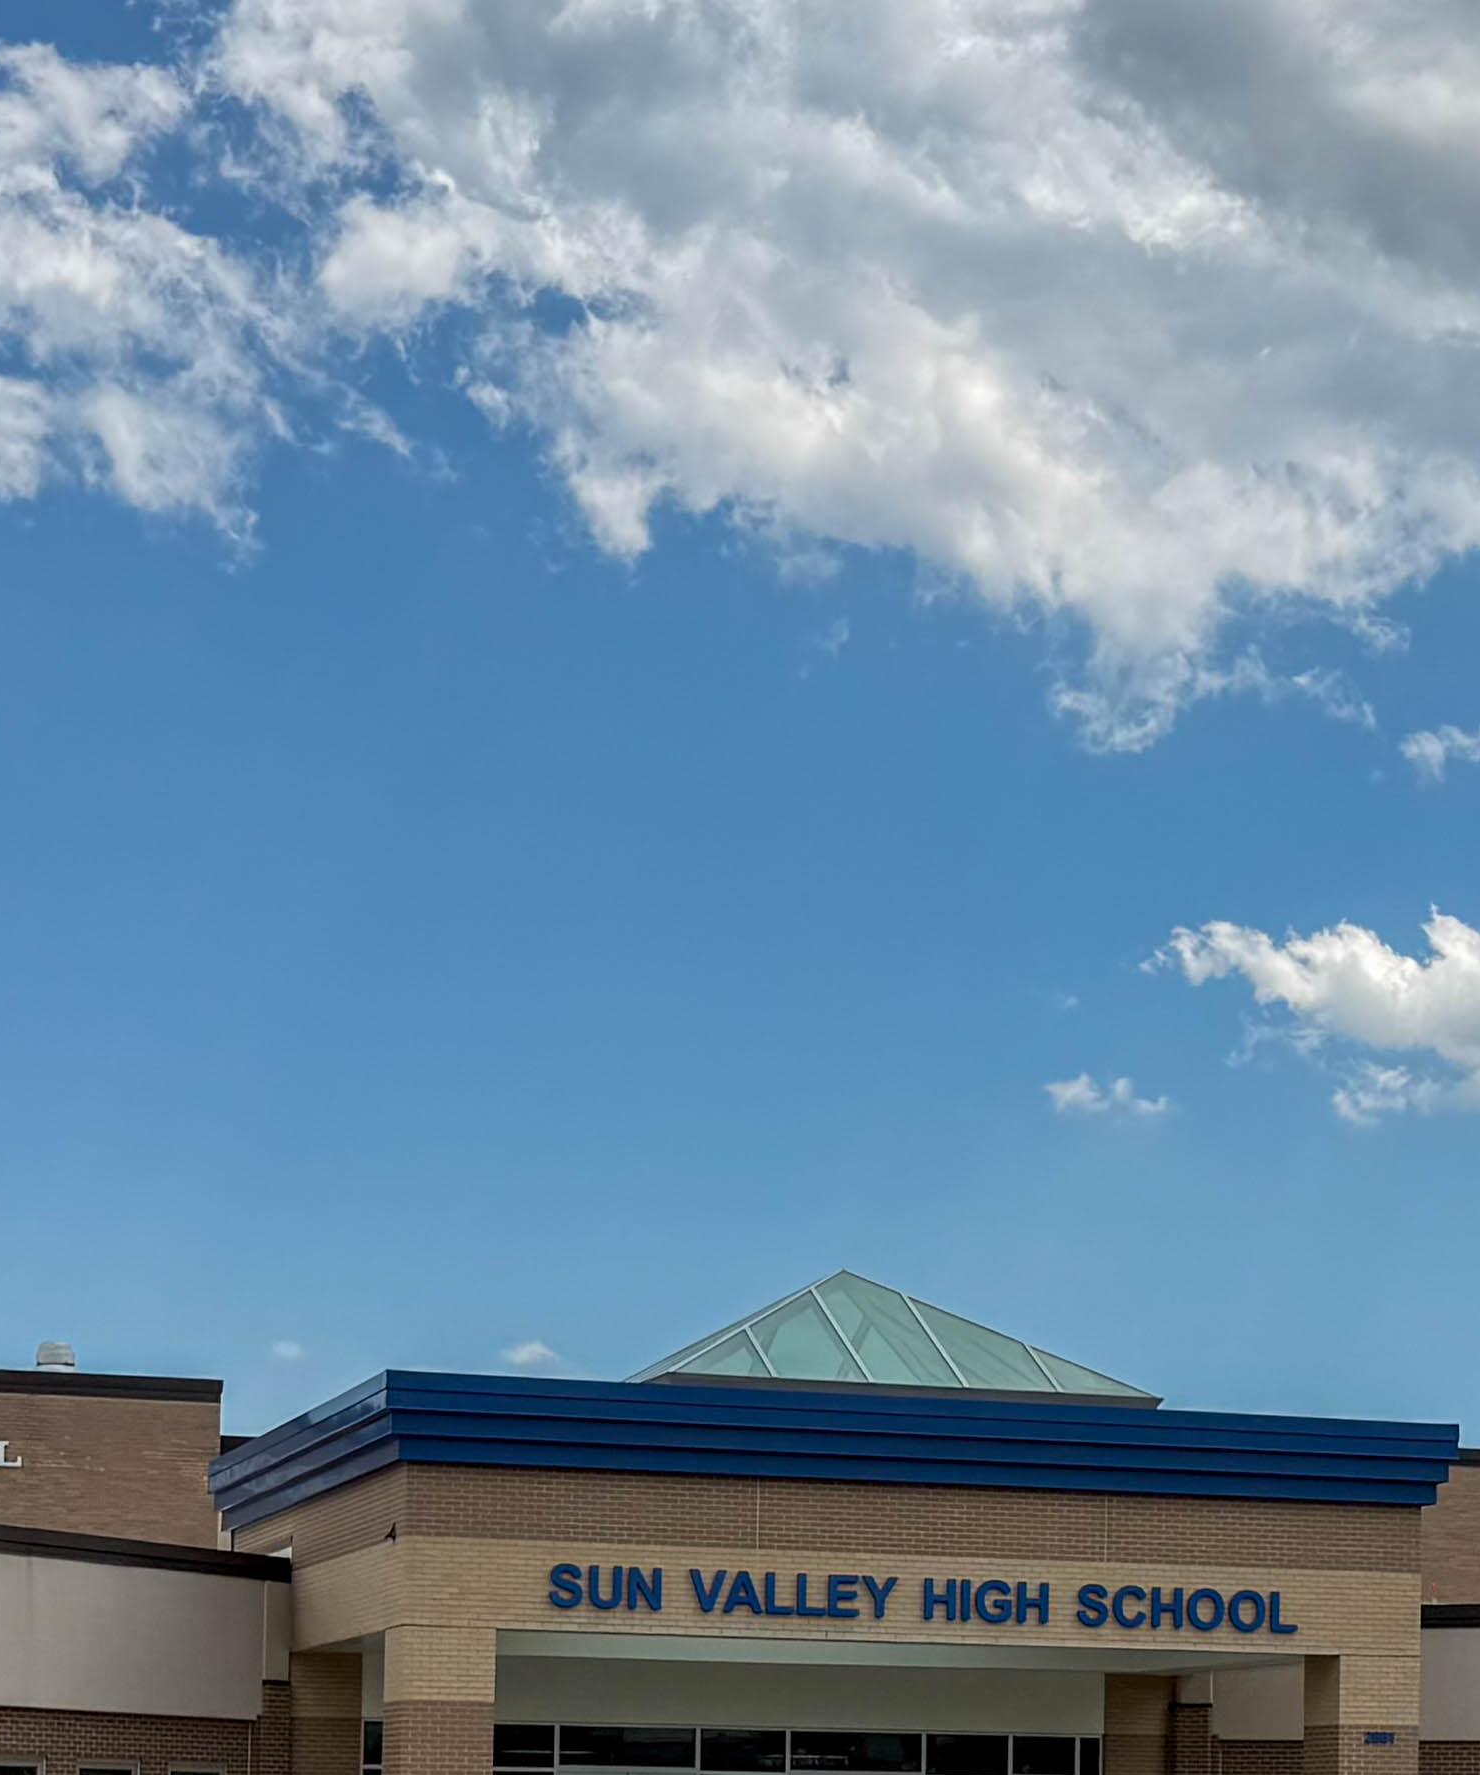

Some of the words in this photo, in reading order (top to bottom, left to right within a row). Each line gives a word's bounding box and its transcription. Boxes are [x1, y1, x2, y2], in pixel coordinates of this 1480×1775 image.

[549, 1562, 663, 1612] SUN
[688, 1568, 899, 1619] VALLEY
[922, 1577, 1050, 1625] HIGH
[1076, 1583, 1299, 1634] SCHOOL
